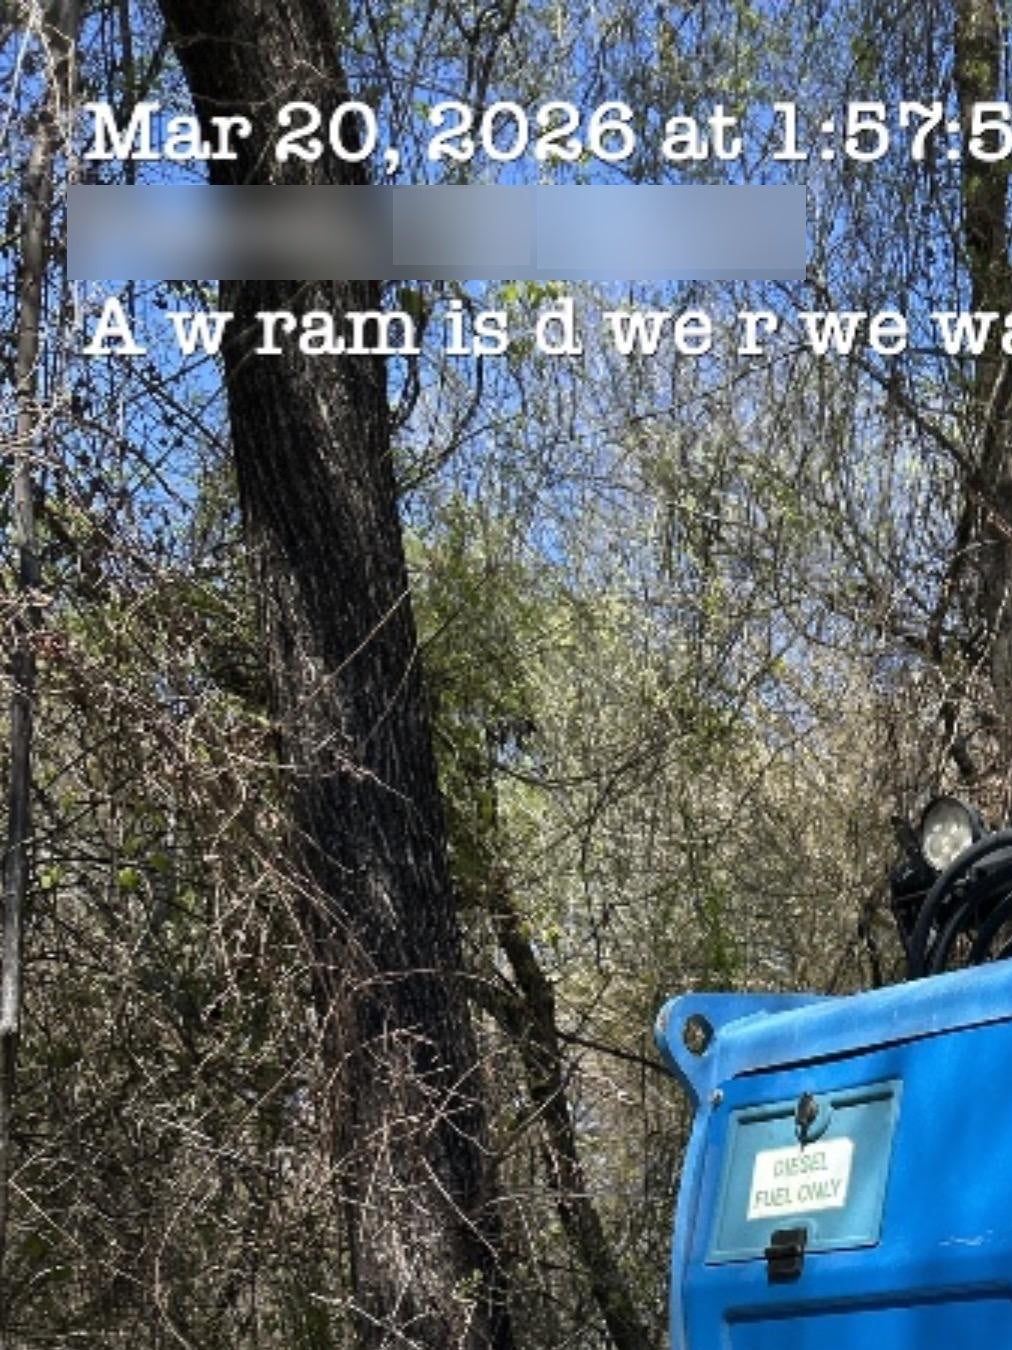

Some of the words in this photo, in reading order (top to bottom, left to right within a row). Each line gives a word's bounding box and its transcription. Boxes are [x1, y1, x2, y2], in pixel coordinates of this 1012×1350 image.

[773, 1151, 828, 1178] DIESEL
[754, 1187, 793, 1210] FUEL
[797, 1178, 842, 1204] ONLY
